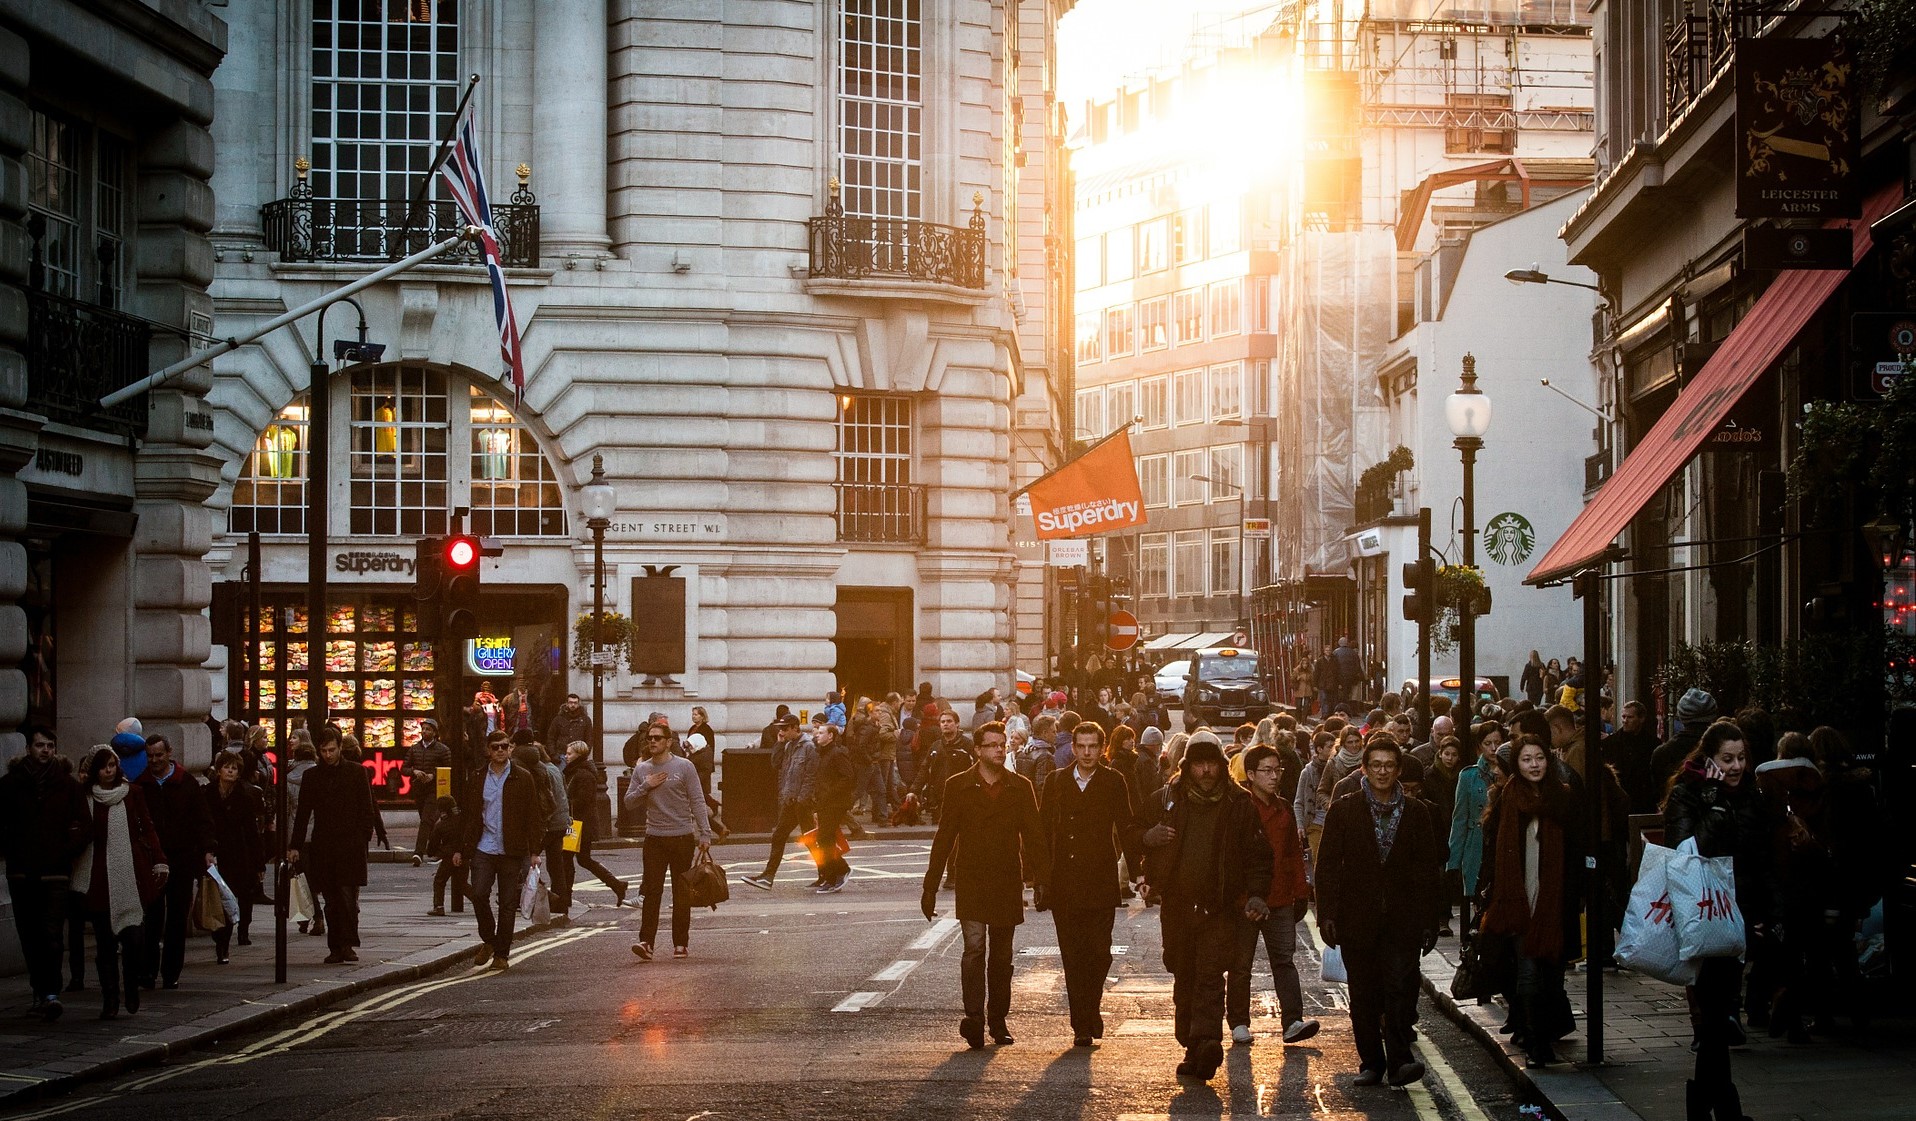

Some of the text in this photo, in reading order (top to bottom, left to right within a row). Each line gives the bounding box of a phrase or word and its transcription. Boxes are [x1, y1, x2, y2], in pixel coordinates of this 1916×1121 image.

[1761, 189, 1839, 200] LEICESTER
[1780, 203, 1821, 212] ARMS
[1038, 499, 1139, 532] Superdry
[605, 523, 644, 533] GENT
[653, 523, 697, 533] STREET
[335, 553, 417, 576] Superdry
[475, 637, 511, 649] T-SHIRT
[1697, 887, 1735, 923] H&M
